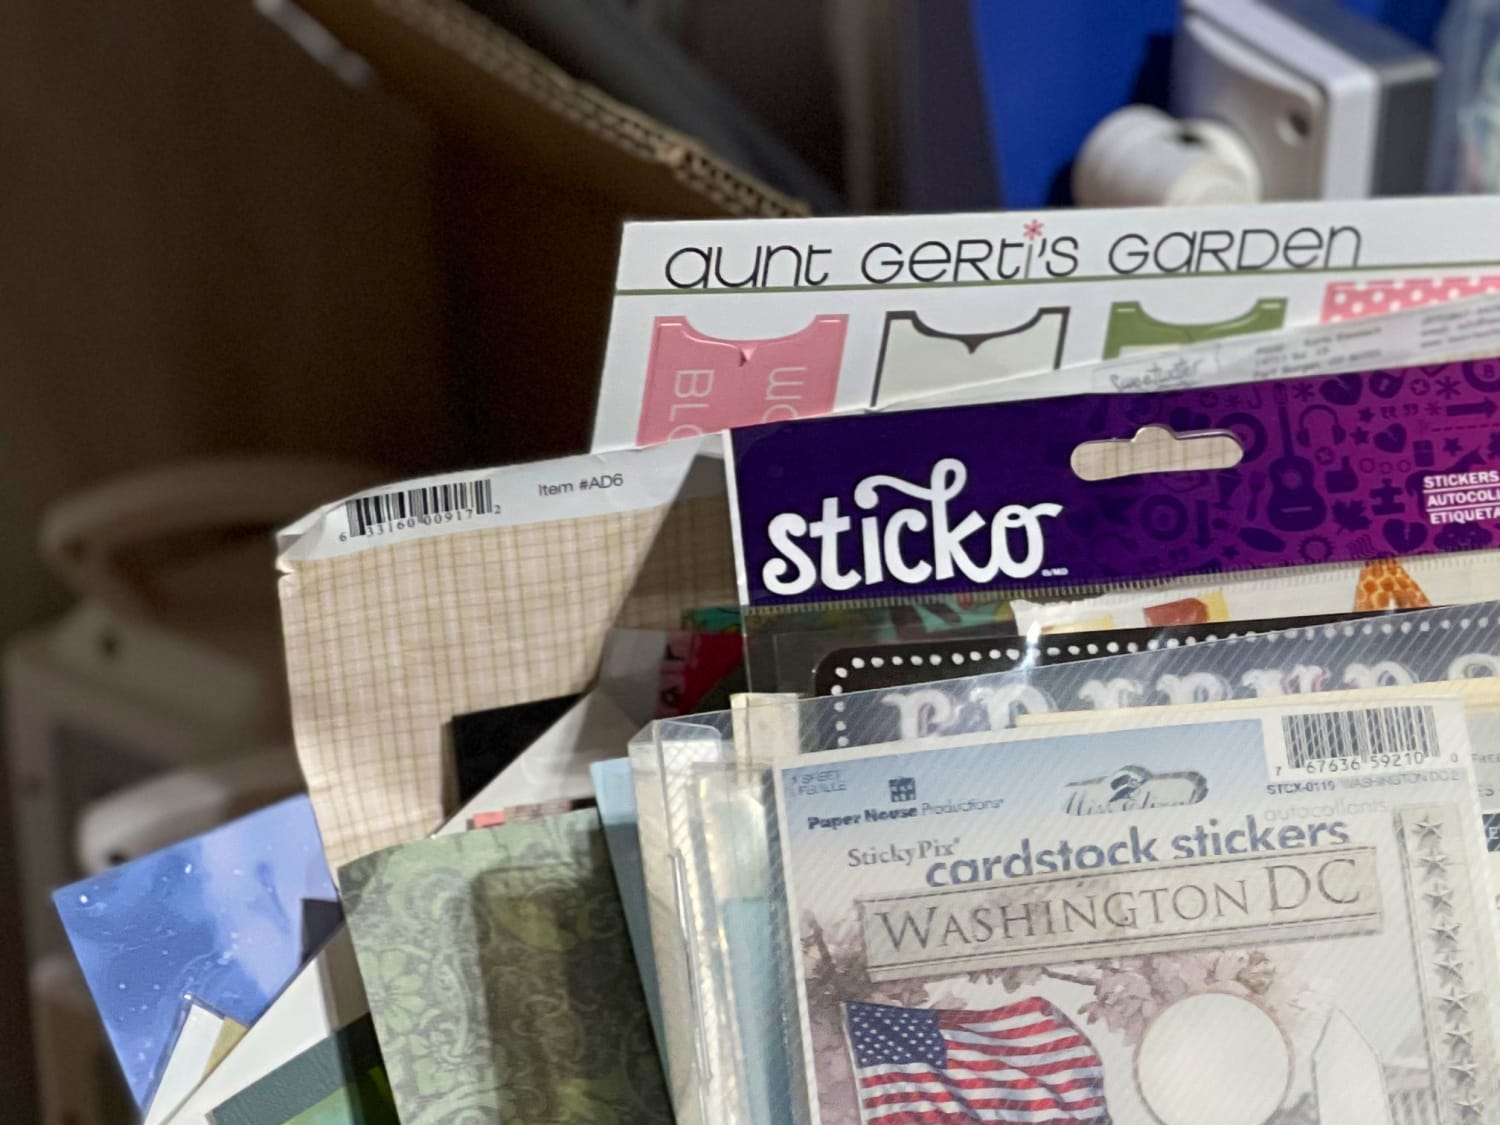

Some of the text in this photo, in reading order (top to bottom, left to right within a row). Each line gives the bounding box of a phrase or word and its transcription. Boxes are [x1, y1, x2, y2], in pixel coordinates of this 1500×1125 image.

[665, 242, 831, 289] aunt
[538, 474, 624, 497] Item #AD6
[1423, 470, 1500, 489] STICKERS
[762, 457, 1064, 595] sticko
[1306, 758, 1360, 774] 67636
[1370, 752, 1425, 769] 59210
[808, 813, 861, 831] Paper
[864, 806, 919, 823] House
[925, 814, 1350, 887] cardstock stickers
[878, 857, 1361, 953] WASHINGTON DC
